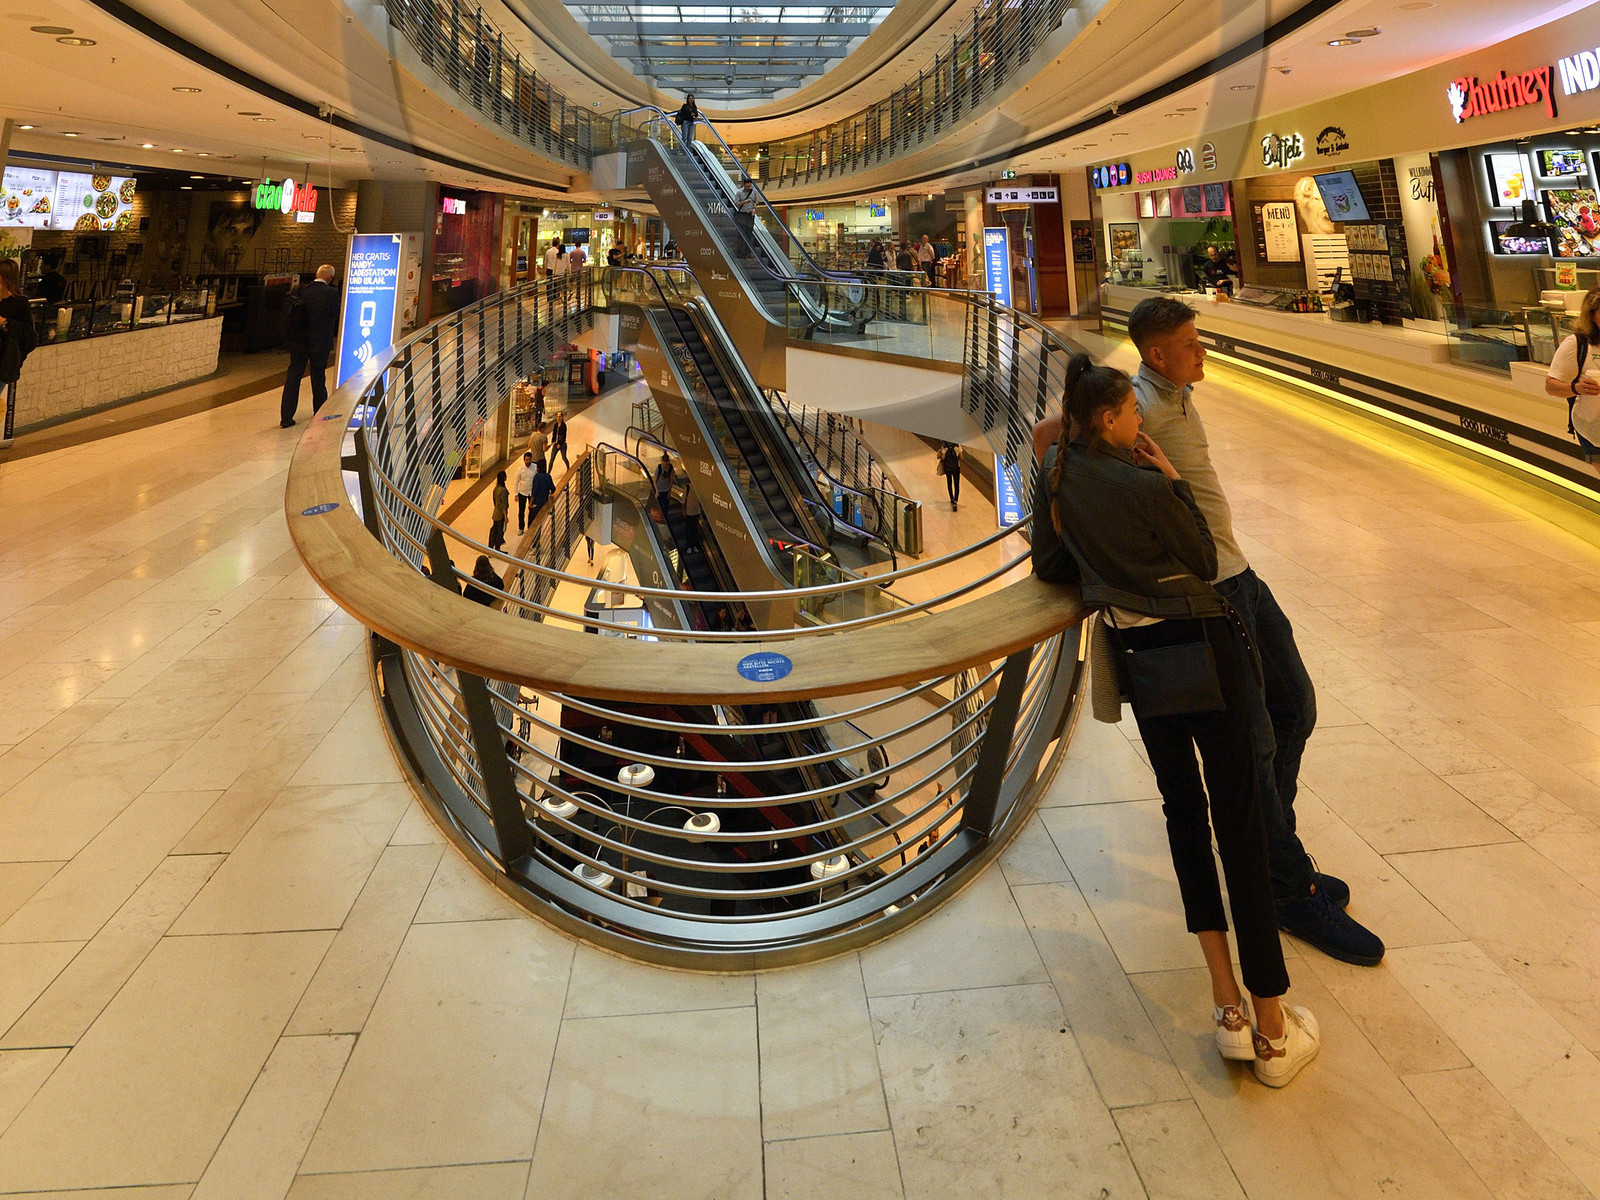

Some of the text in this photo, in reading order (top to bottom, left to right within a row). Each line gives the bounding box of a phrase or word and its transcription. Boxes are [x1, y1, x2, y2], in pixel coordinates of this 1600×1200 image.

[1454, 66, 1554, 119] Chutney
[1136, 167, 1177, 184] SUSHI LOUNGE
[255, 177, 319, 212] ciao bella
[1267, 205, 1291, 220] MENÜ
[365, 252, 391, 261] GRATIS:
[350, 268, 396, 277] LADESTATION
[351, 261, 375, 269] HANDY-
[1460, 416, 1510, 444] FOOD LOUNGE
